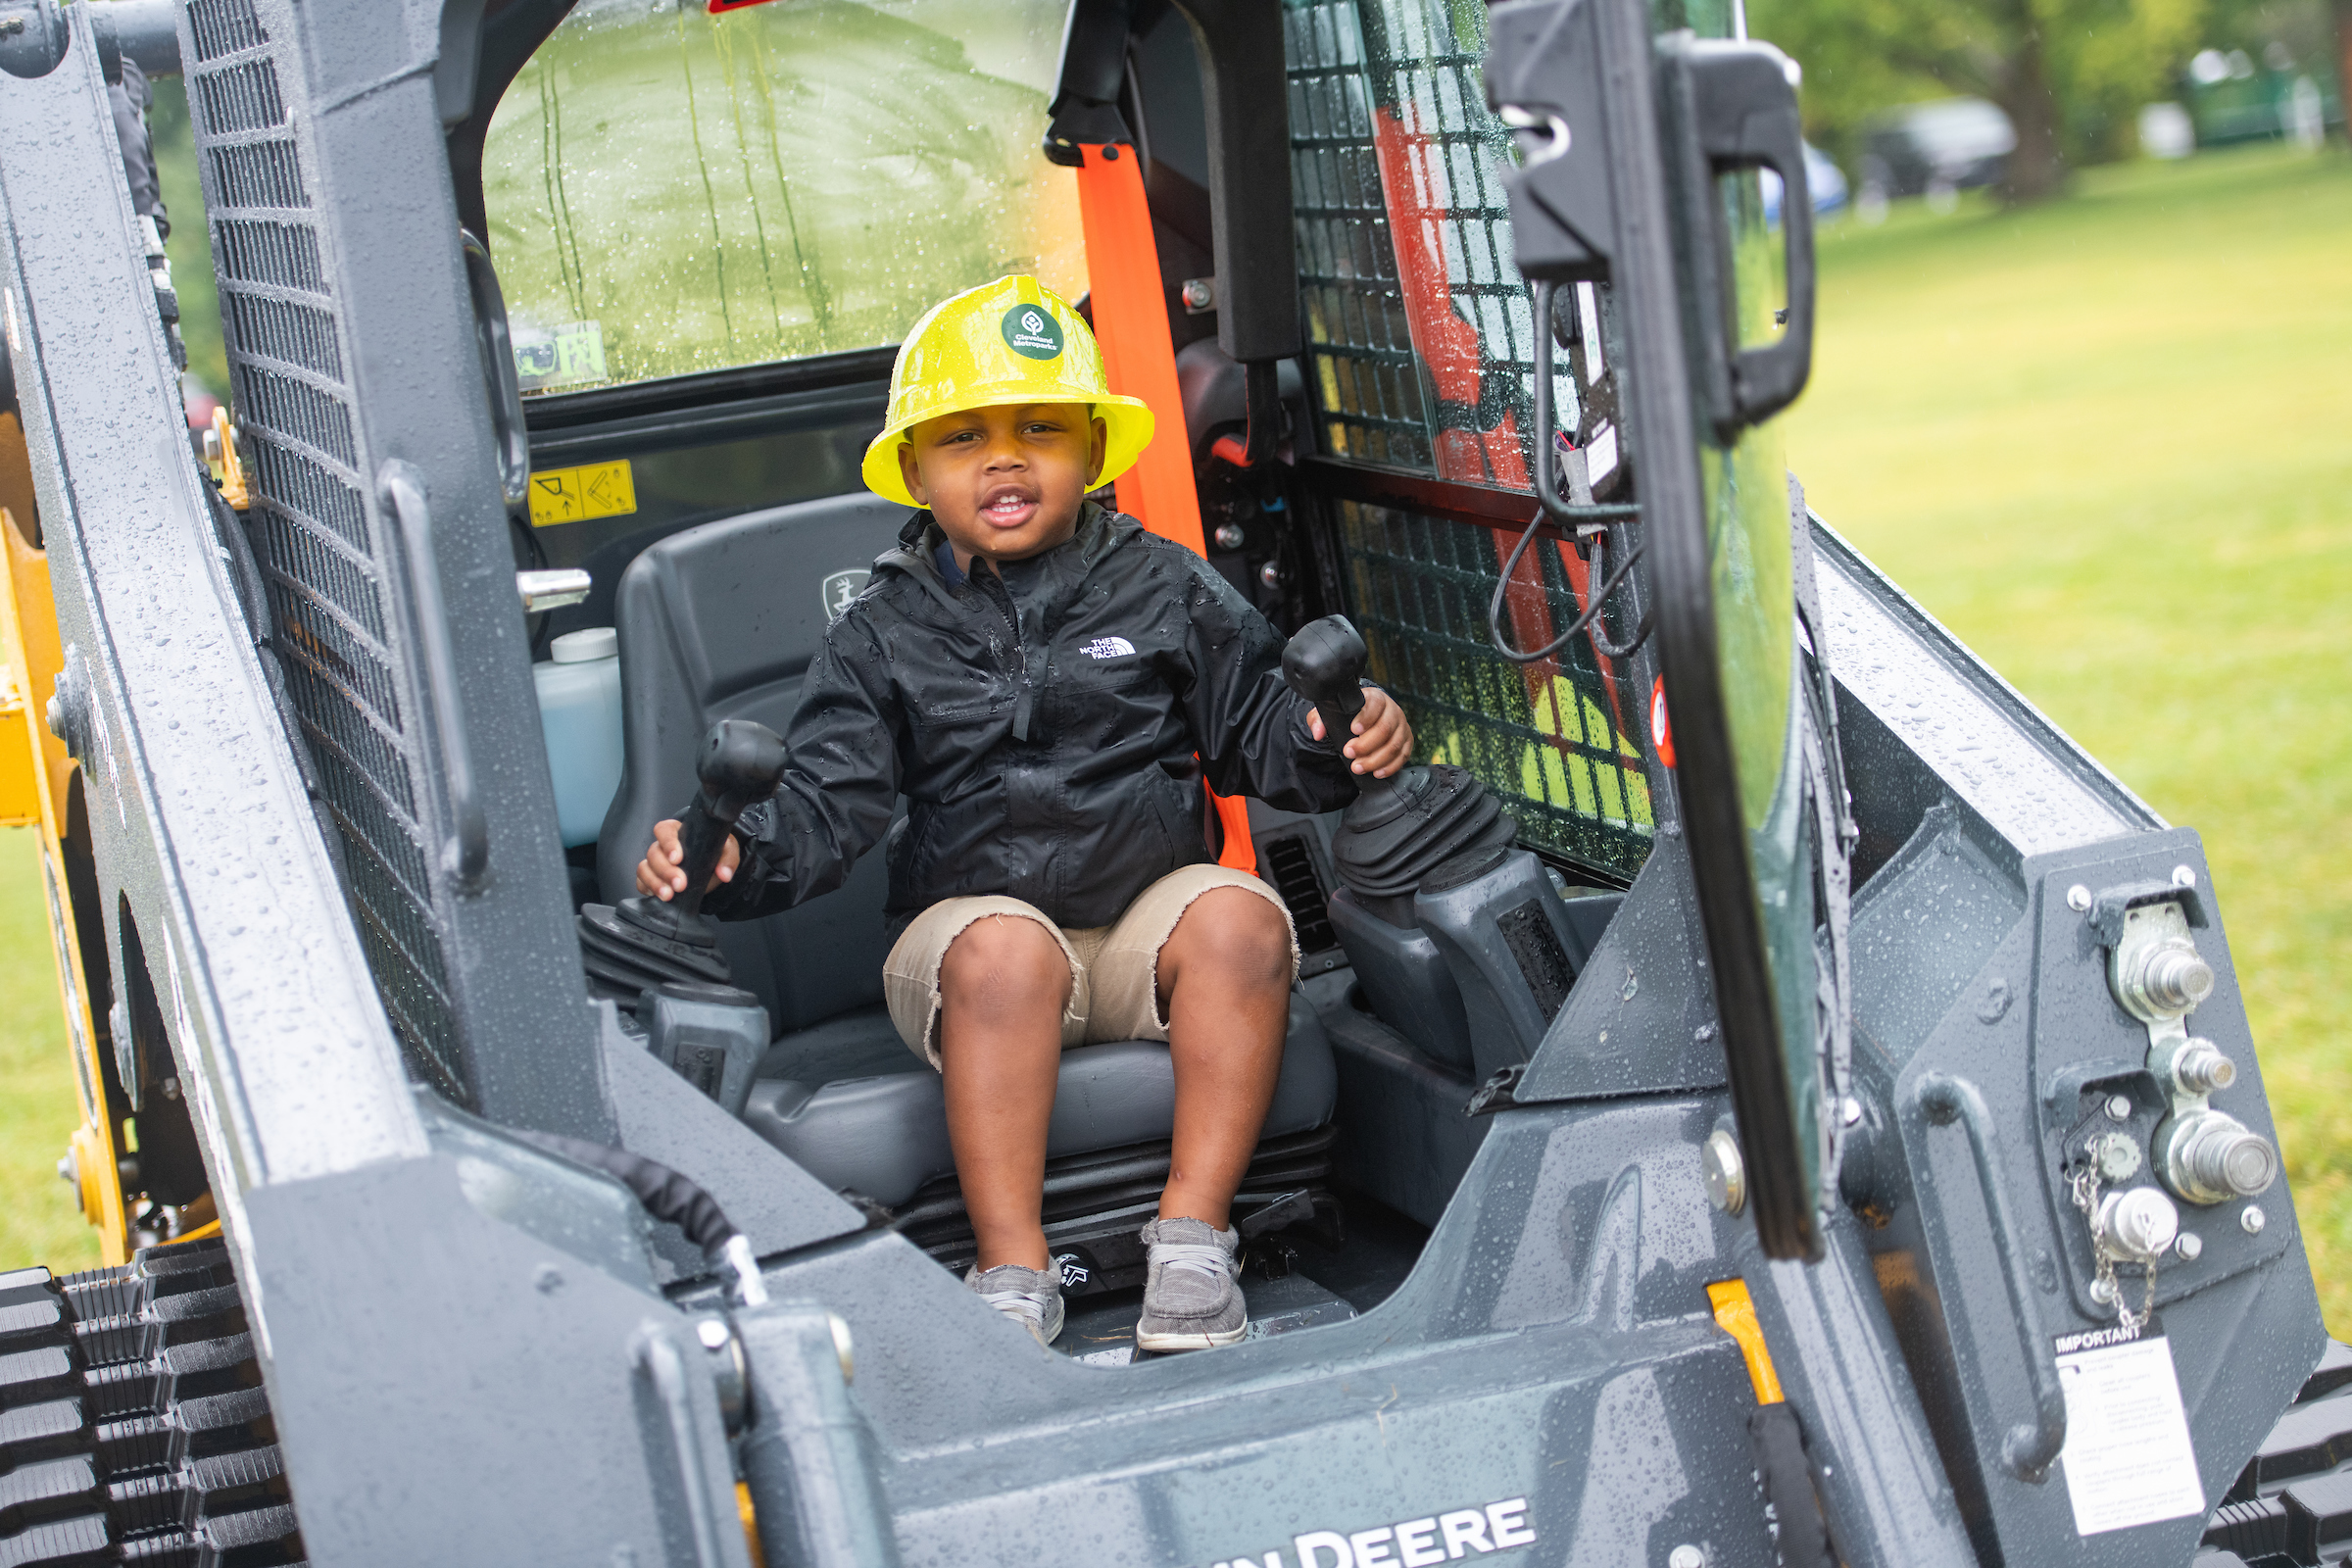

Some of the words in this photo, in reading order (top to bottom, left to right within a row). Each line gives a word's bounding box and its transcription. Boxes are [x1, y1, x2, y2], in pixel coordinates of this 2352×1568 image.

[1015, 334, 1053, 344] Cleveland
[1013, 340, 1057, 350] Metroparks
[1091, 637, 1111, 647] THE
[1079, 644, 1115, 655] NORTH
[1091, 650, 1118, 660] FACE
[2056, 1325, 2140, 1353] IMPORTANT
[1295, 1497, 1537, 1568] DEERE
